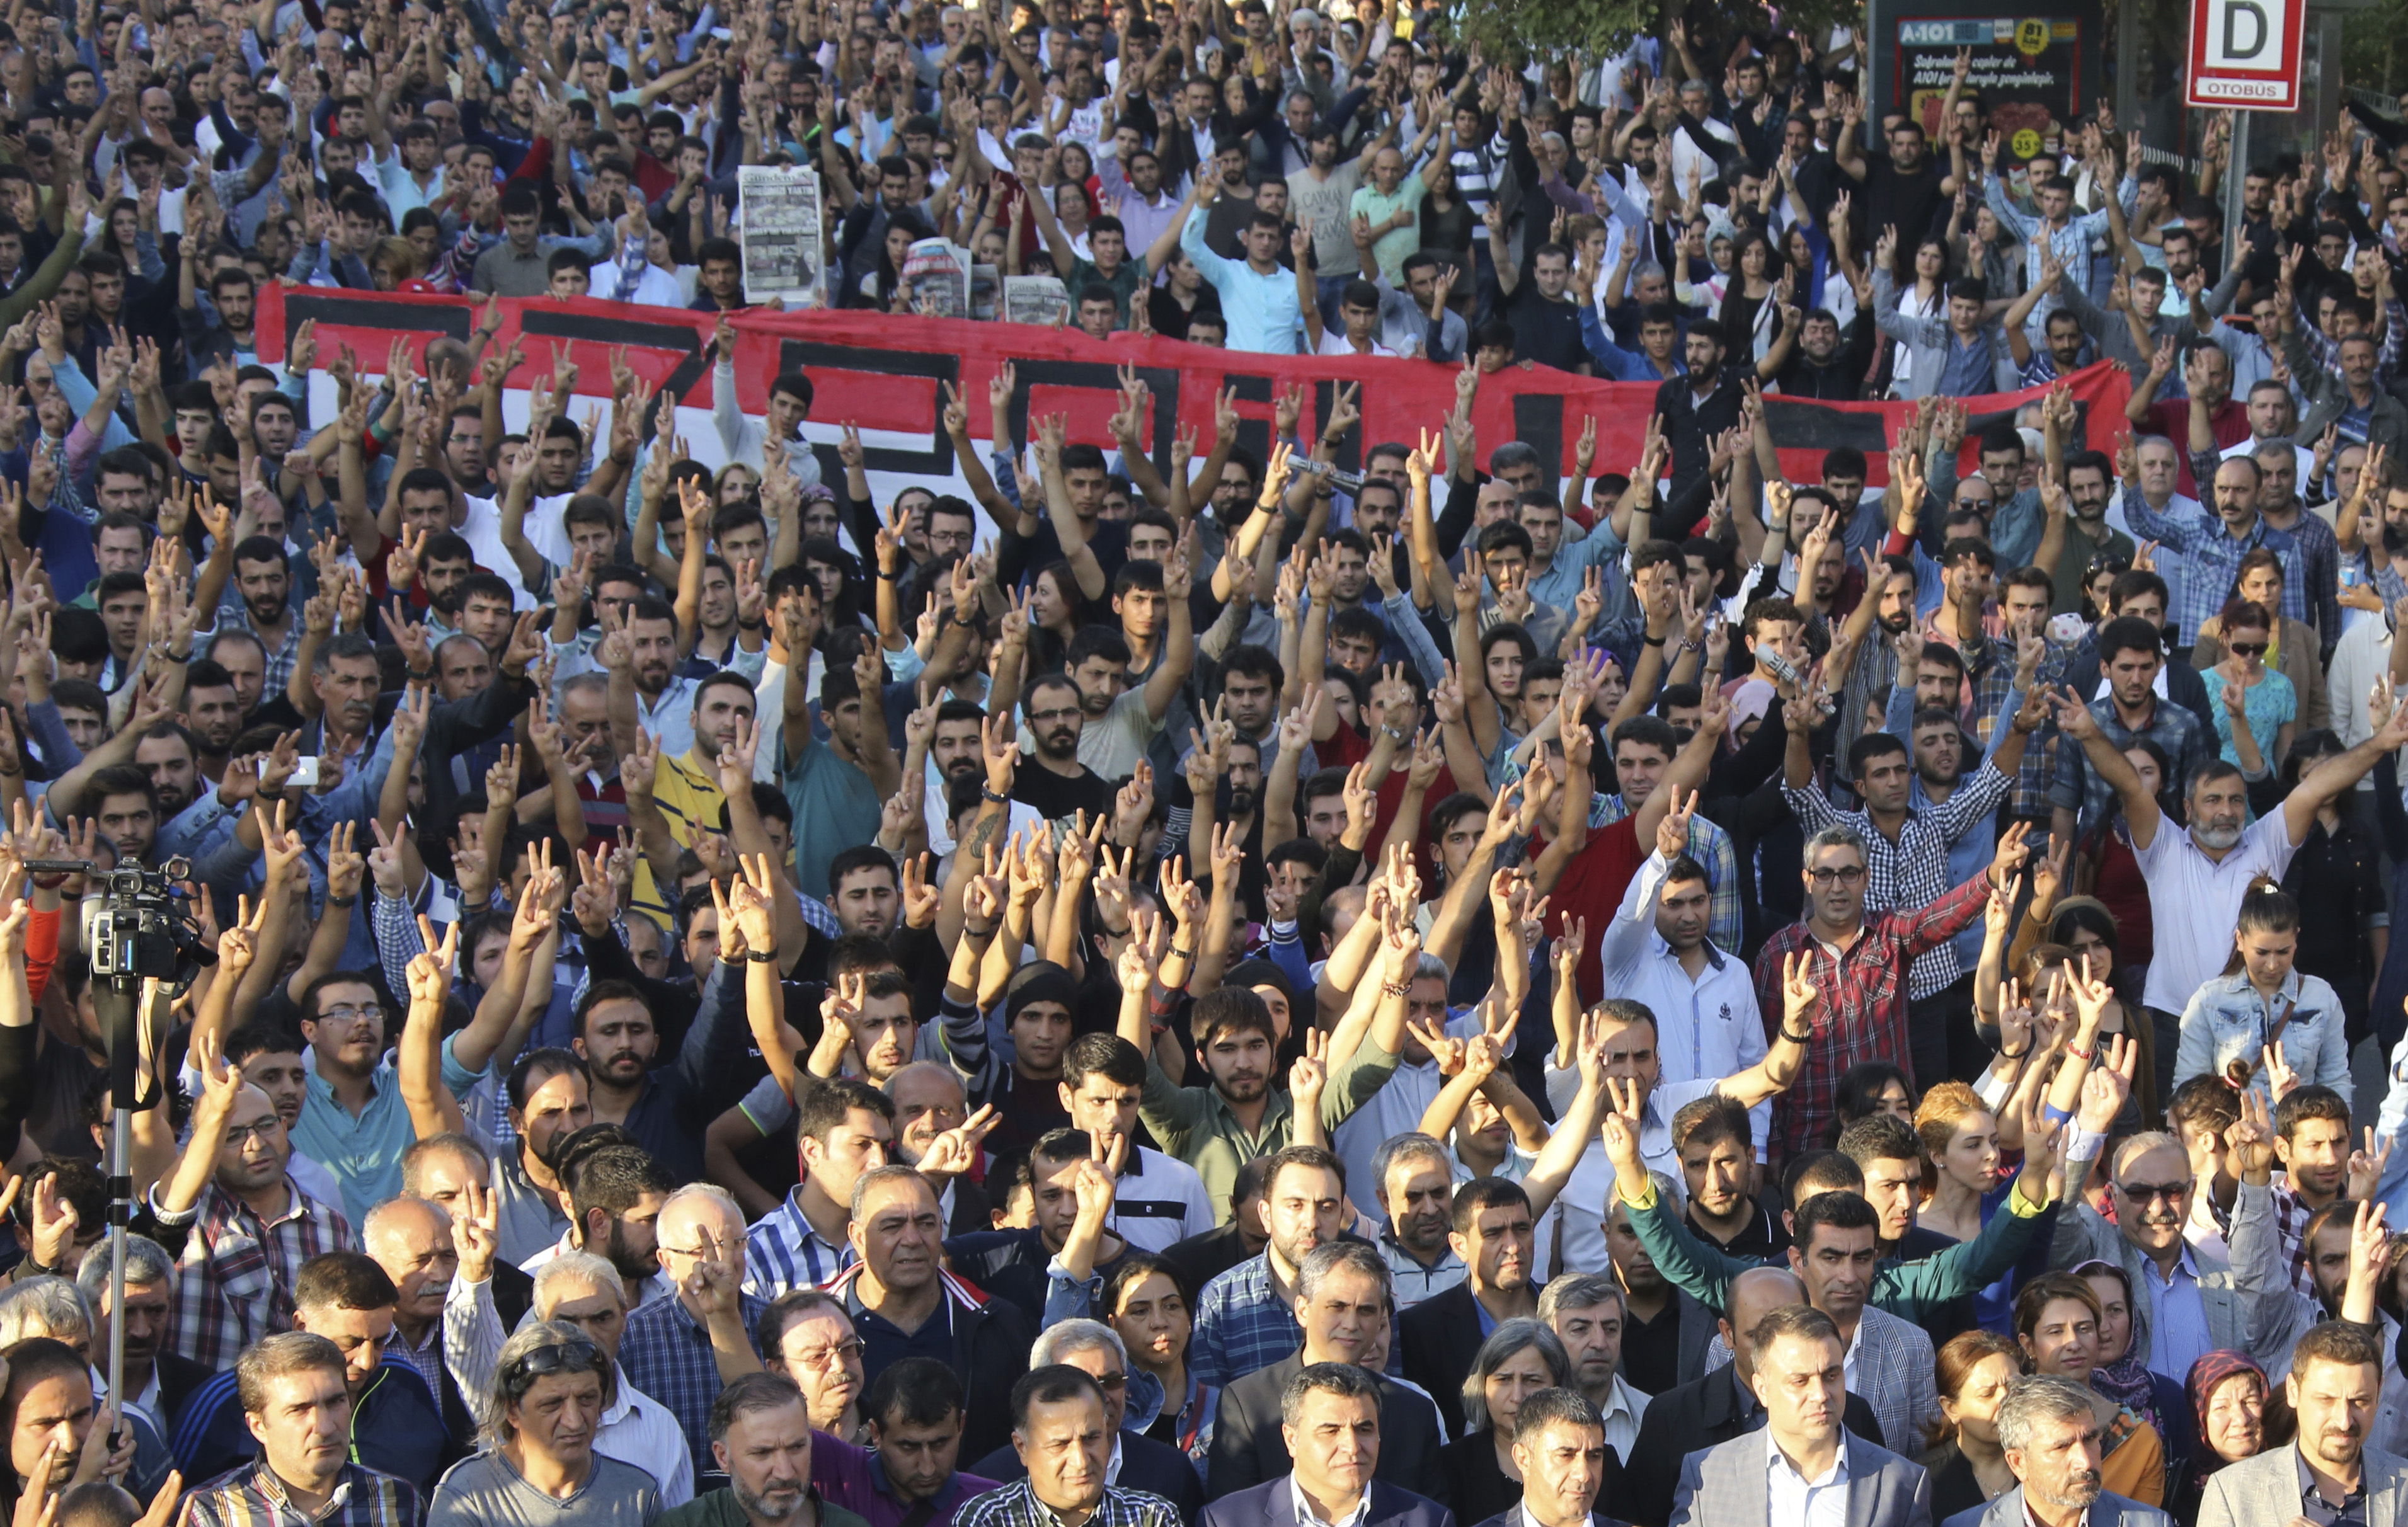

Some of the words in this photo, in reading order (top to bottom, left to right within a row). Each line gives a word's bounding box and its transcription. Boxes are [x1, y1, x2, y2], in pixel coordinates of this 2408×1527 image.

[2025, 23, 2042, 36] 81
[2223, 0, 2268, 59] D
[2208, 82, 2276, 97] OTOBÜS
